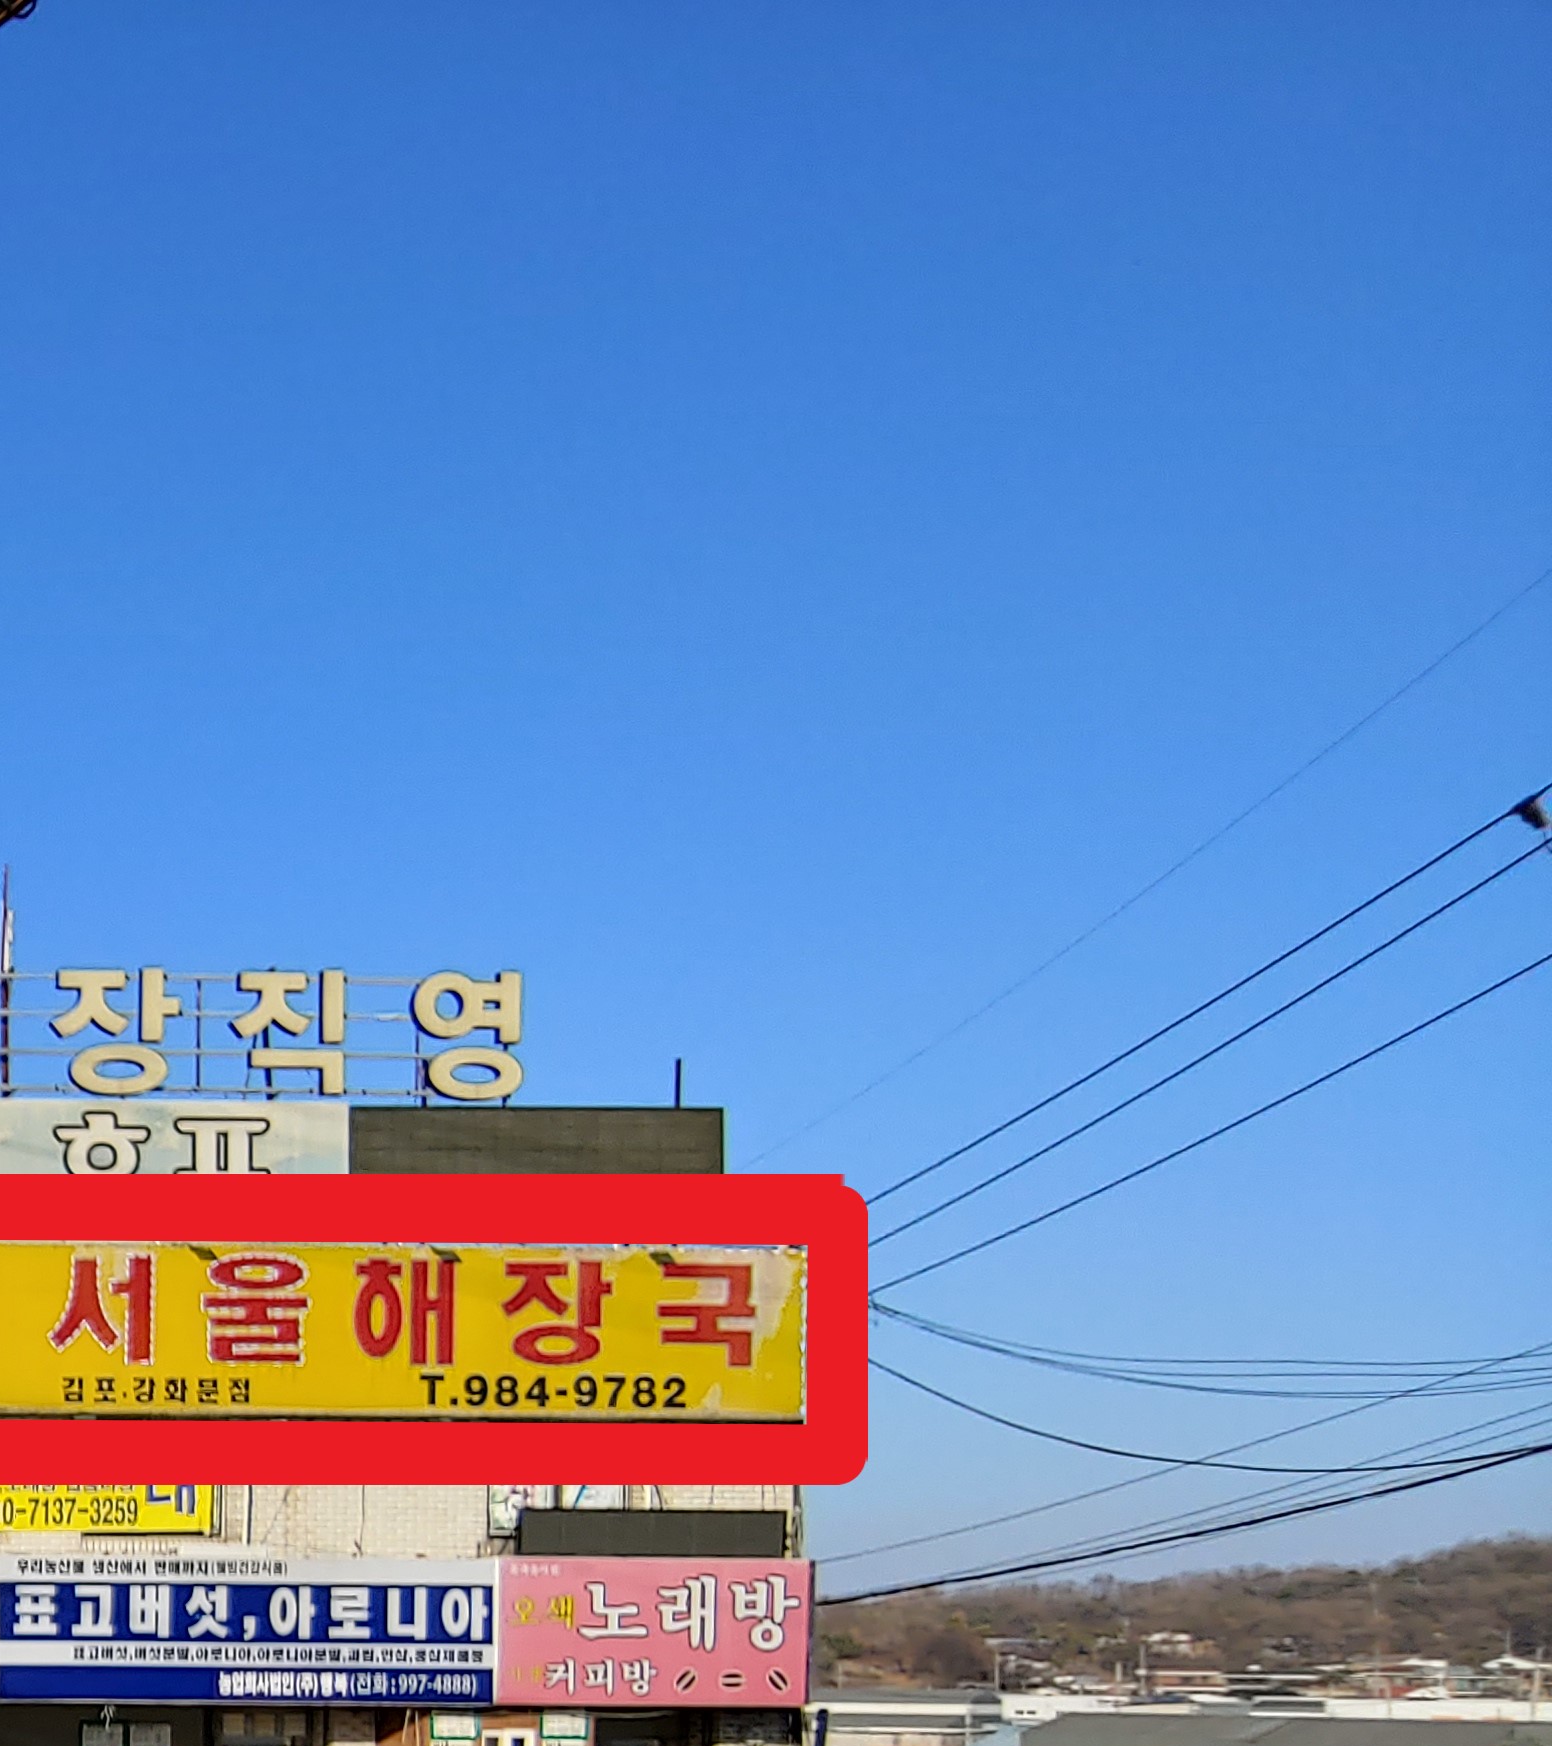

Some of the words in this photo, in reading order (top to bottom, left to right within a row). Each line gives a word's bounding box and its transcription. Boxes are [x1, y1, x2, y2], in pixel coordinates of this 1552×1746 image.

[420, 1375, 689, 1411] T.984-9782
[12, 1583, 489, 1641] 표고버섯,아로니아
[577, 1573, 800, 1651] 노래방
[544, 1656, 657, 1696] 커피방
